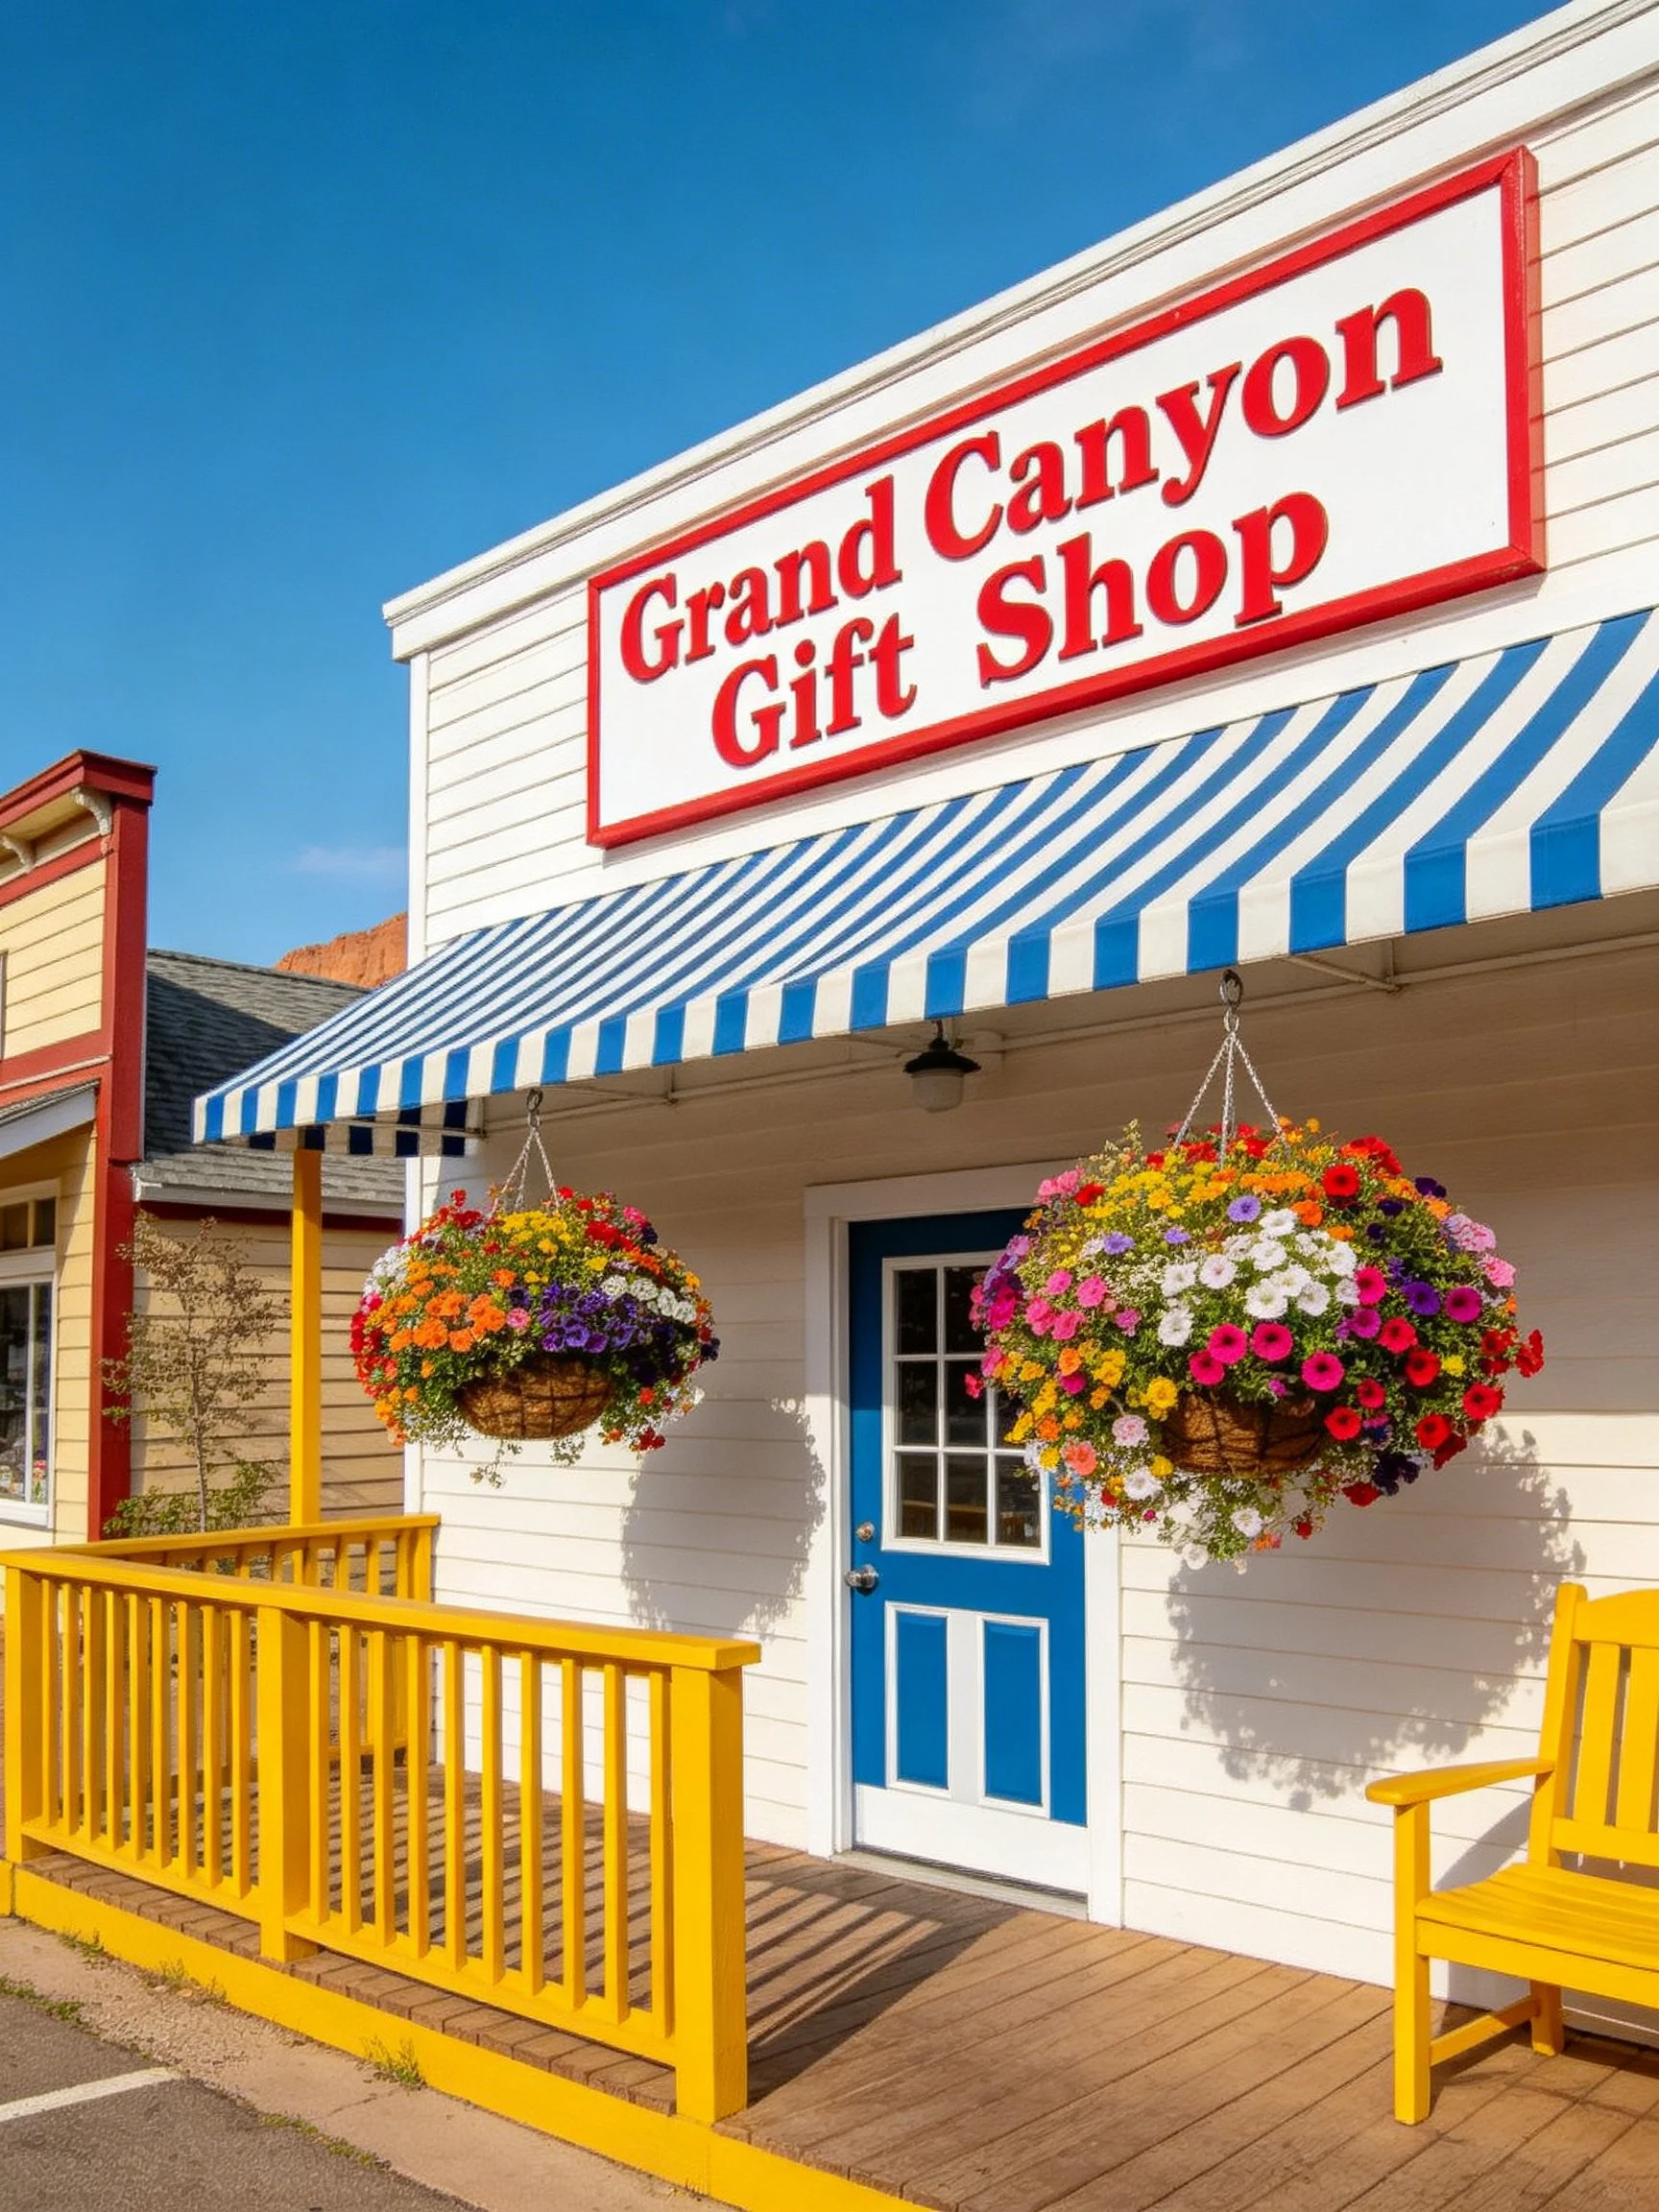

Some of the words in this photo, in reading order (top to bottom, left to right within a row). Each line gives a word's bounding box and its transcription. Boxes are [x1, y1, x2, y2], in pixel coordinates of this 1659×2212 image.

[620, 476, 901, 682] Grand
[925, 288, 1442, 561] Canyon
[711, 615, 916, 768] Gift
[976, 493, 1329, 685] Shop
